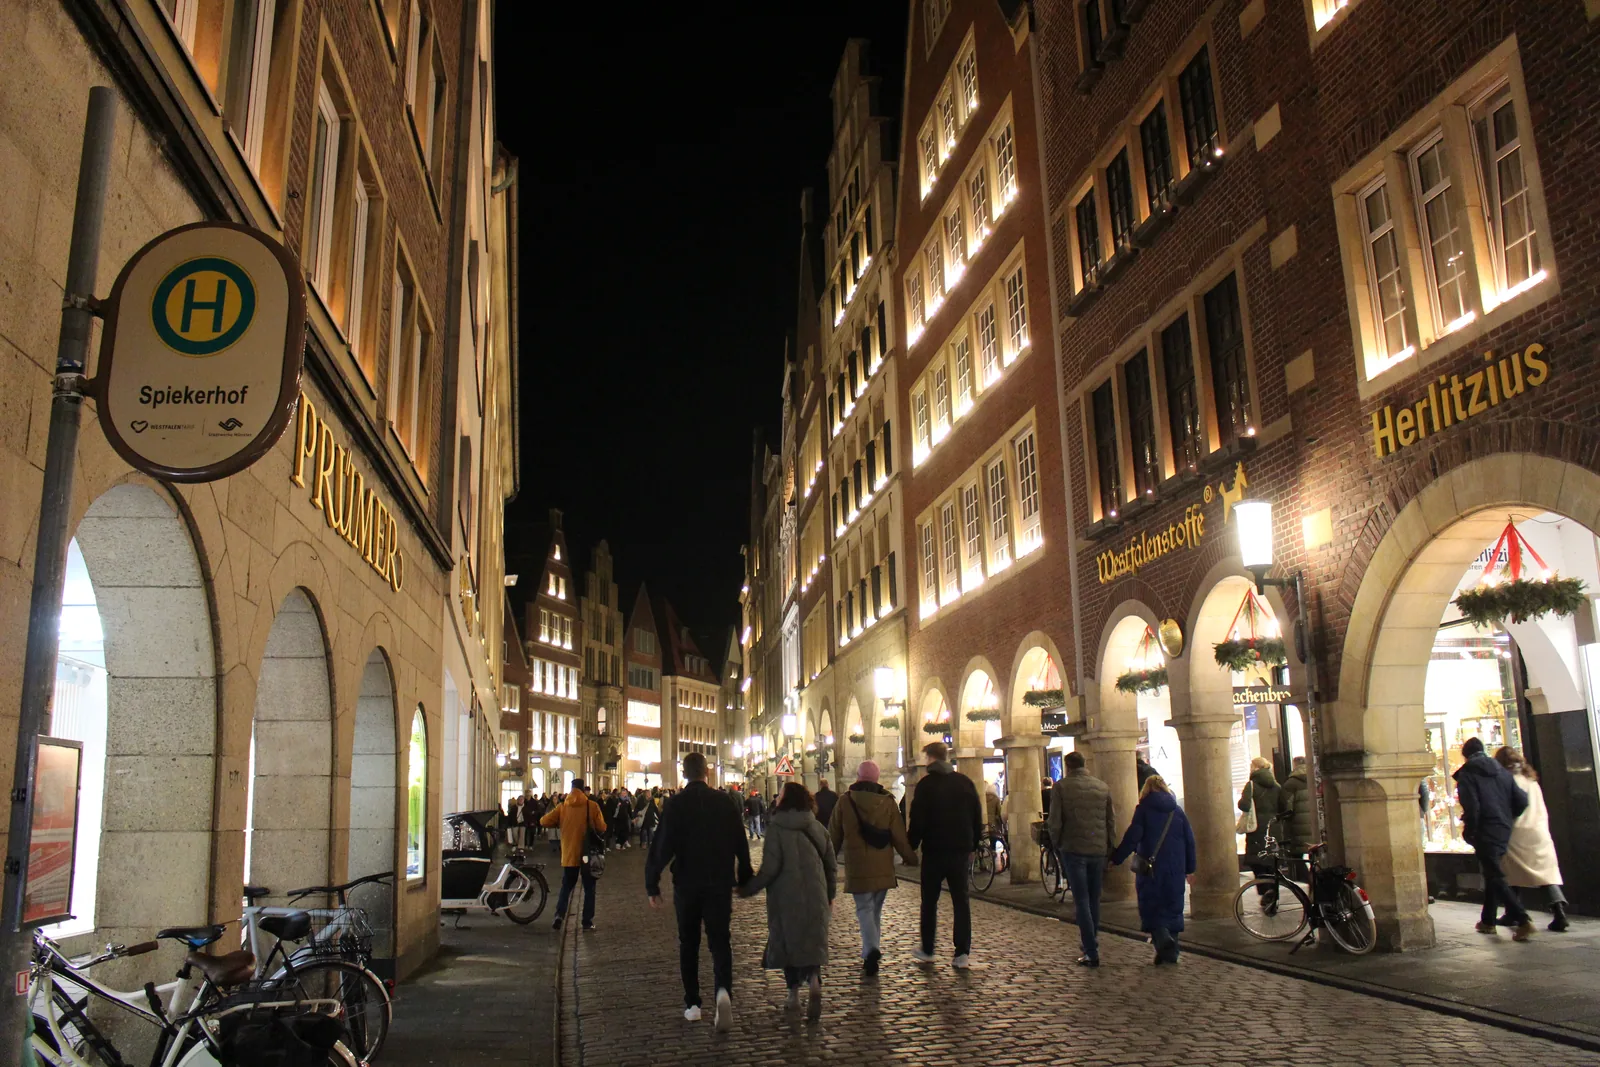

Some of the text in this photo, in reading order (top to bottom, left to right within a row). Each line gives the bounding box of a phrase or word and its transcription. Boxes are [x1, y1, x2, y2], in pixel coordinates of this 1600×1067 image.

[180, 279, 228, 334] H
[139, 385, 249, 409] Spiekerhof
[1372, 343, 1549, 458] Herlitzius
[289, 391, 404, 593] PRÜMER
[1096, 504, 1205, 585] Westfalenstoffe
